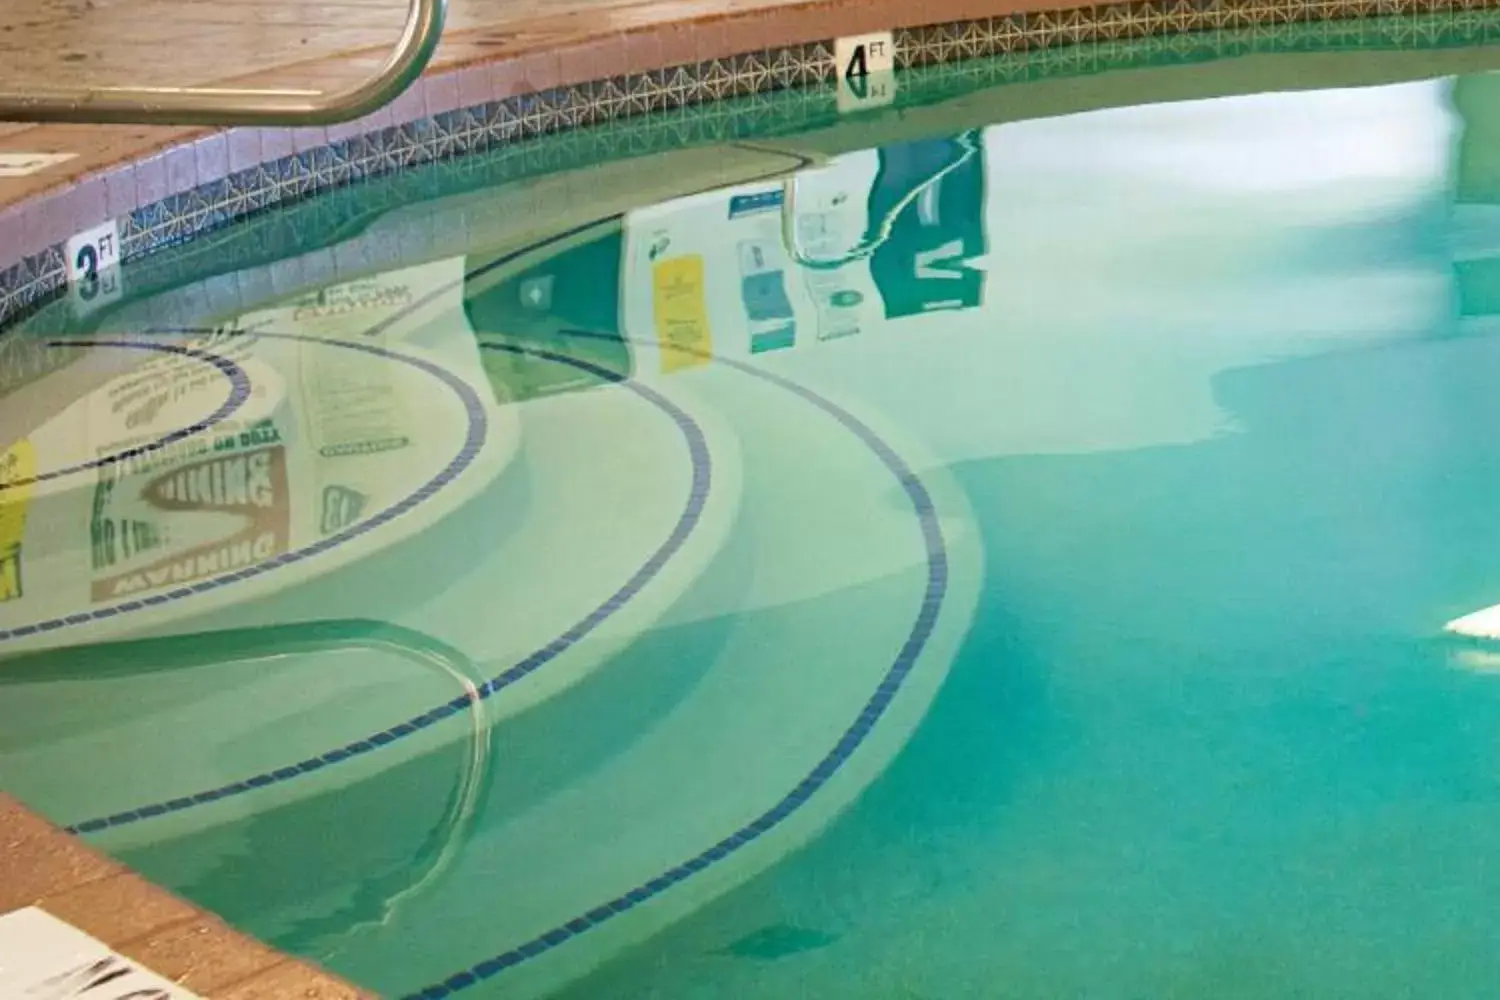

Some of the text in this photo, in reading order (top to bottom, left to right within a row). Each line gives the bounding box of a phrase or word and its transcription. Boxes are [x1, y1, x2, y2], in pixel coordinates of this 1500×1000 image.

[845, 40, 886, 82] 4 FT
[77, 232, 114, 285] 3 FT
